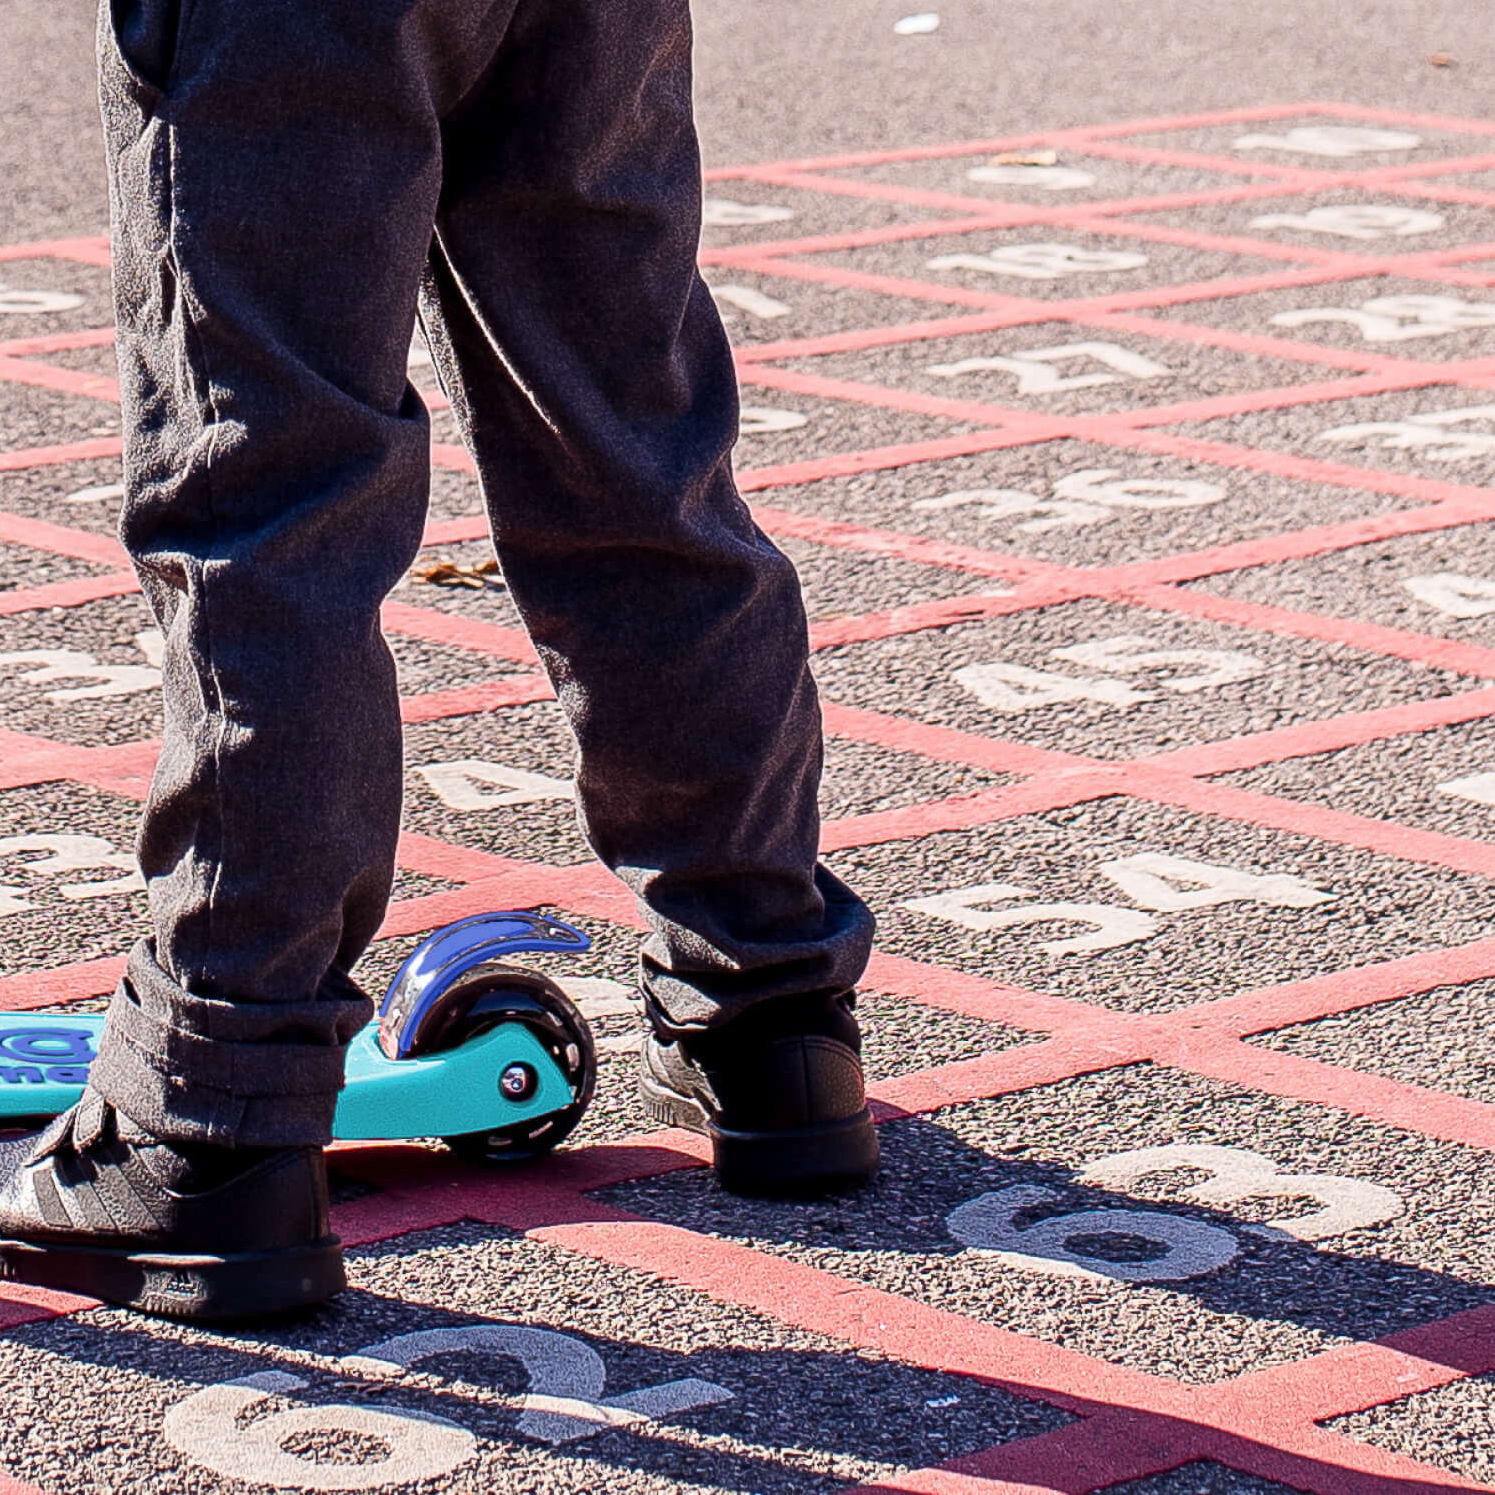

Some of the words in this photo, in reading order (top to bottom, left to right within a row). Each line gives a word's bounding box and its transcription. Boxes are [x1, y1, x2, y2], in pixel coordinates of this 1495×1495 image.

[926, 242, 1149, 279] 18
[925, 341, 1171, 395] 27
[914, 468, 1228, 533] 36
[951, 634, 1267, 712] 45
[413, 760, 577, 811] 4
[901, 851, 1338, 956] 54
[945, 1143, 1406, 1283] 63
[163, 1323, 737, 1489] 62
